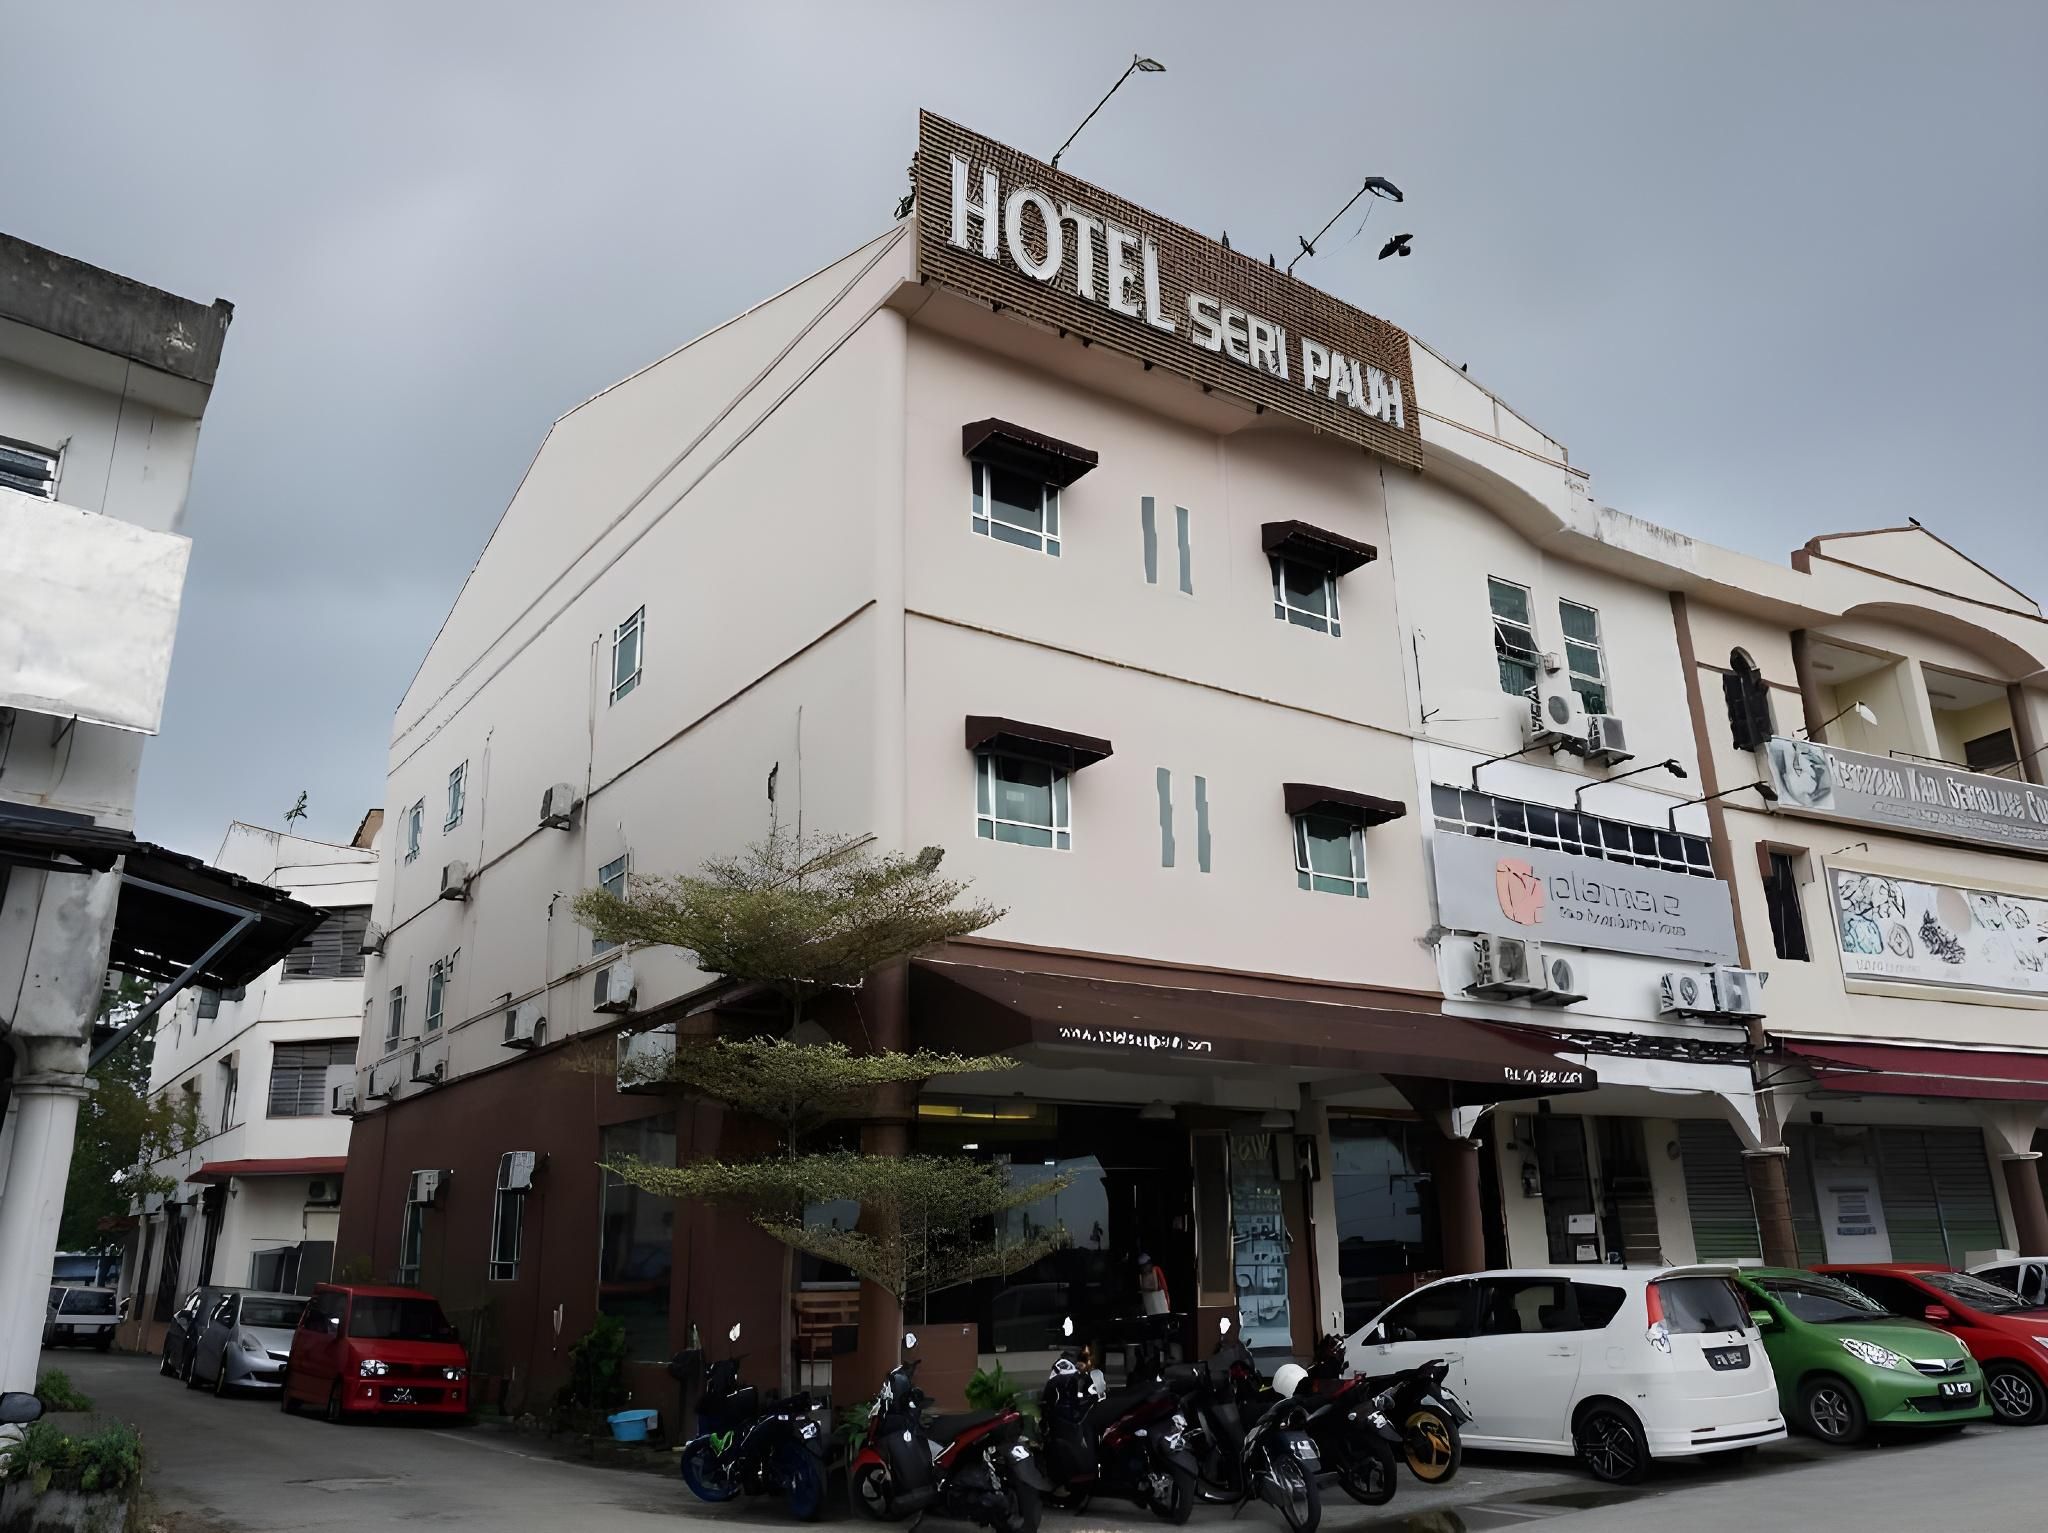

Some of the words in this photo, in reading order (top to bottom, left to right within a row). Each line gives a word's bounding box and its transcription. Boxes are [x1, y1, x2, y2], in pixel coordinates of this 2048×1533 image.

[947, 152, 1177, 333] HOTEL
[1187, 291, 1290, 381] SERI
[1302, 335, 1405, 428] PAUH
